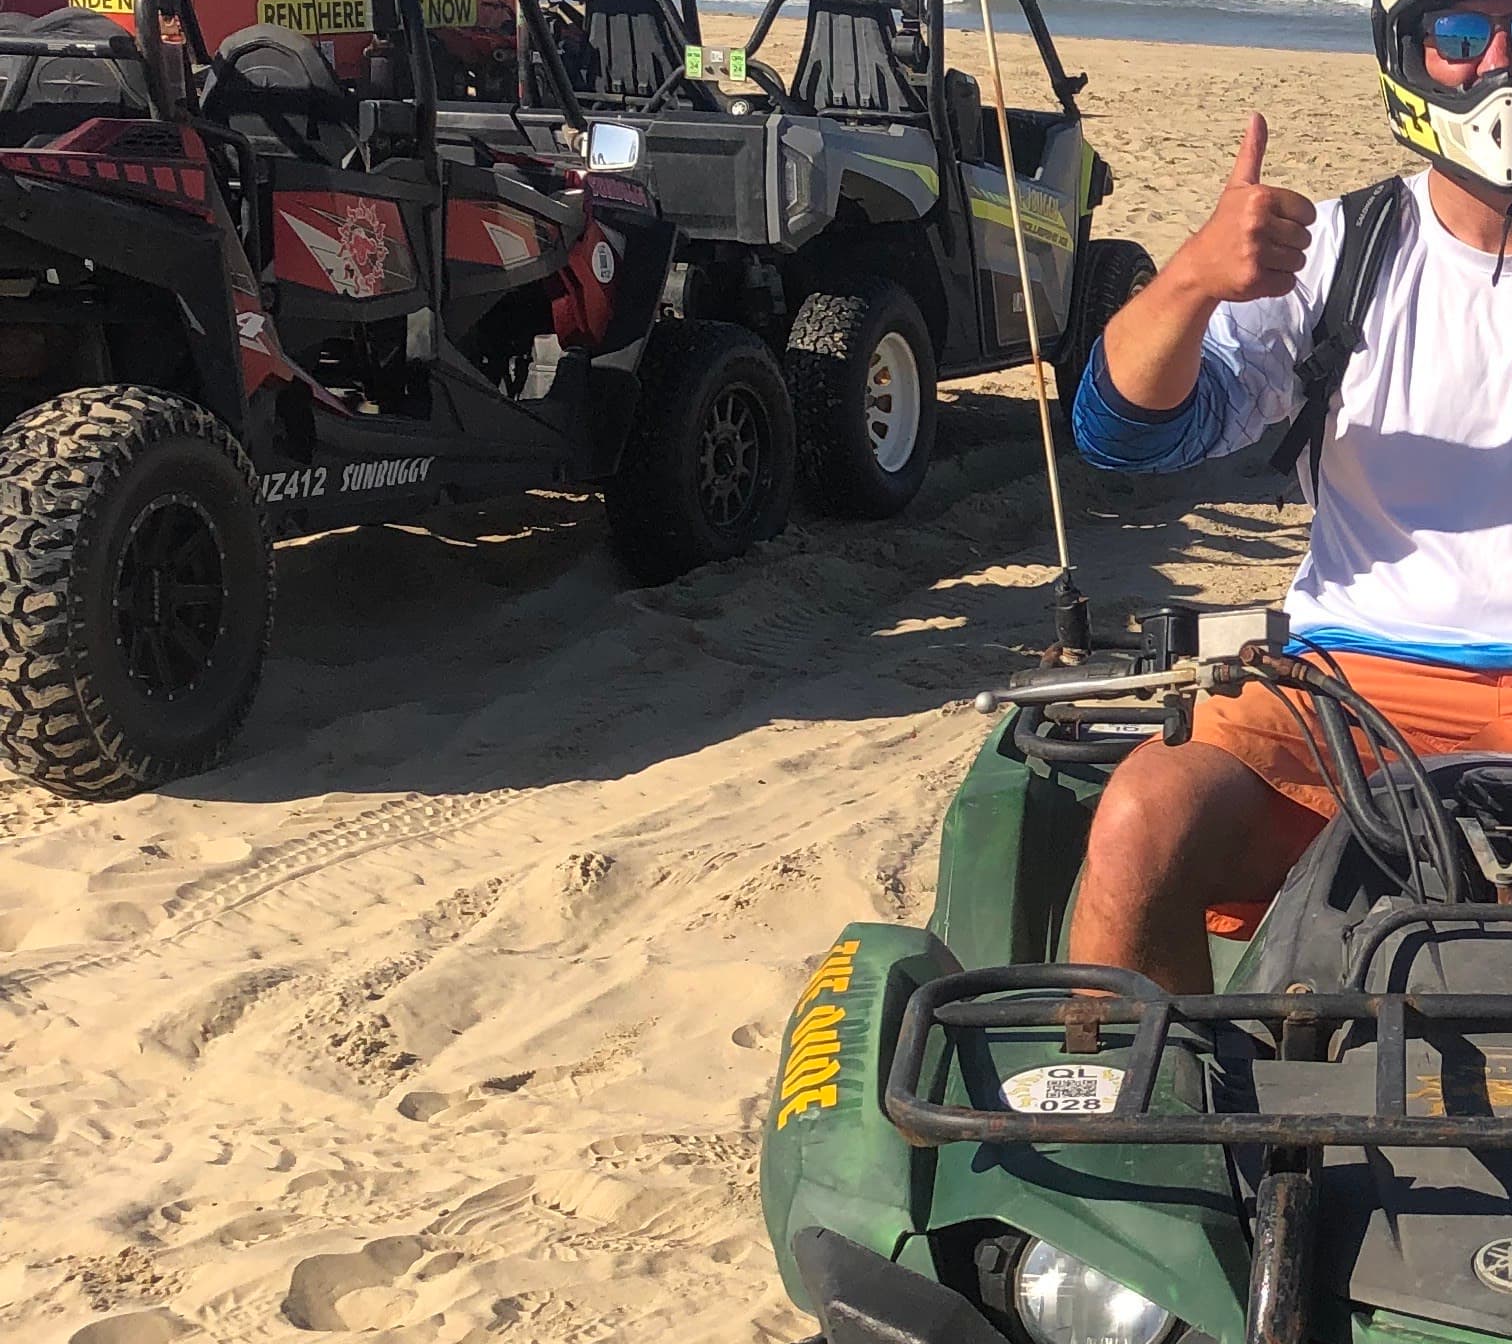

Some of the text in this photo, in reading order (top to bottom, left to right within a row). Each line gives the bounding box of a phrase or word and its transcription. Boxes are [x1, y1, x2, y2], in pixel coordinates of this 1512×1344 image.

[264, 0, 365, 30] RENT HERE
[340, 456, 435, 493] SUNBUGGY
[1047, 1067, 1098, 1080] QL
[1039, 1098, 1102, 1112] 028
